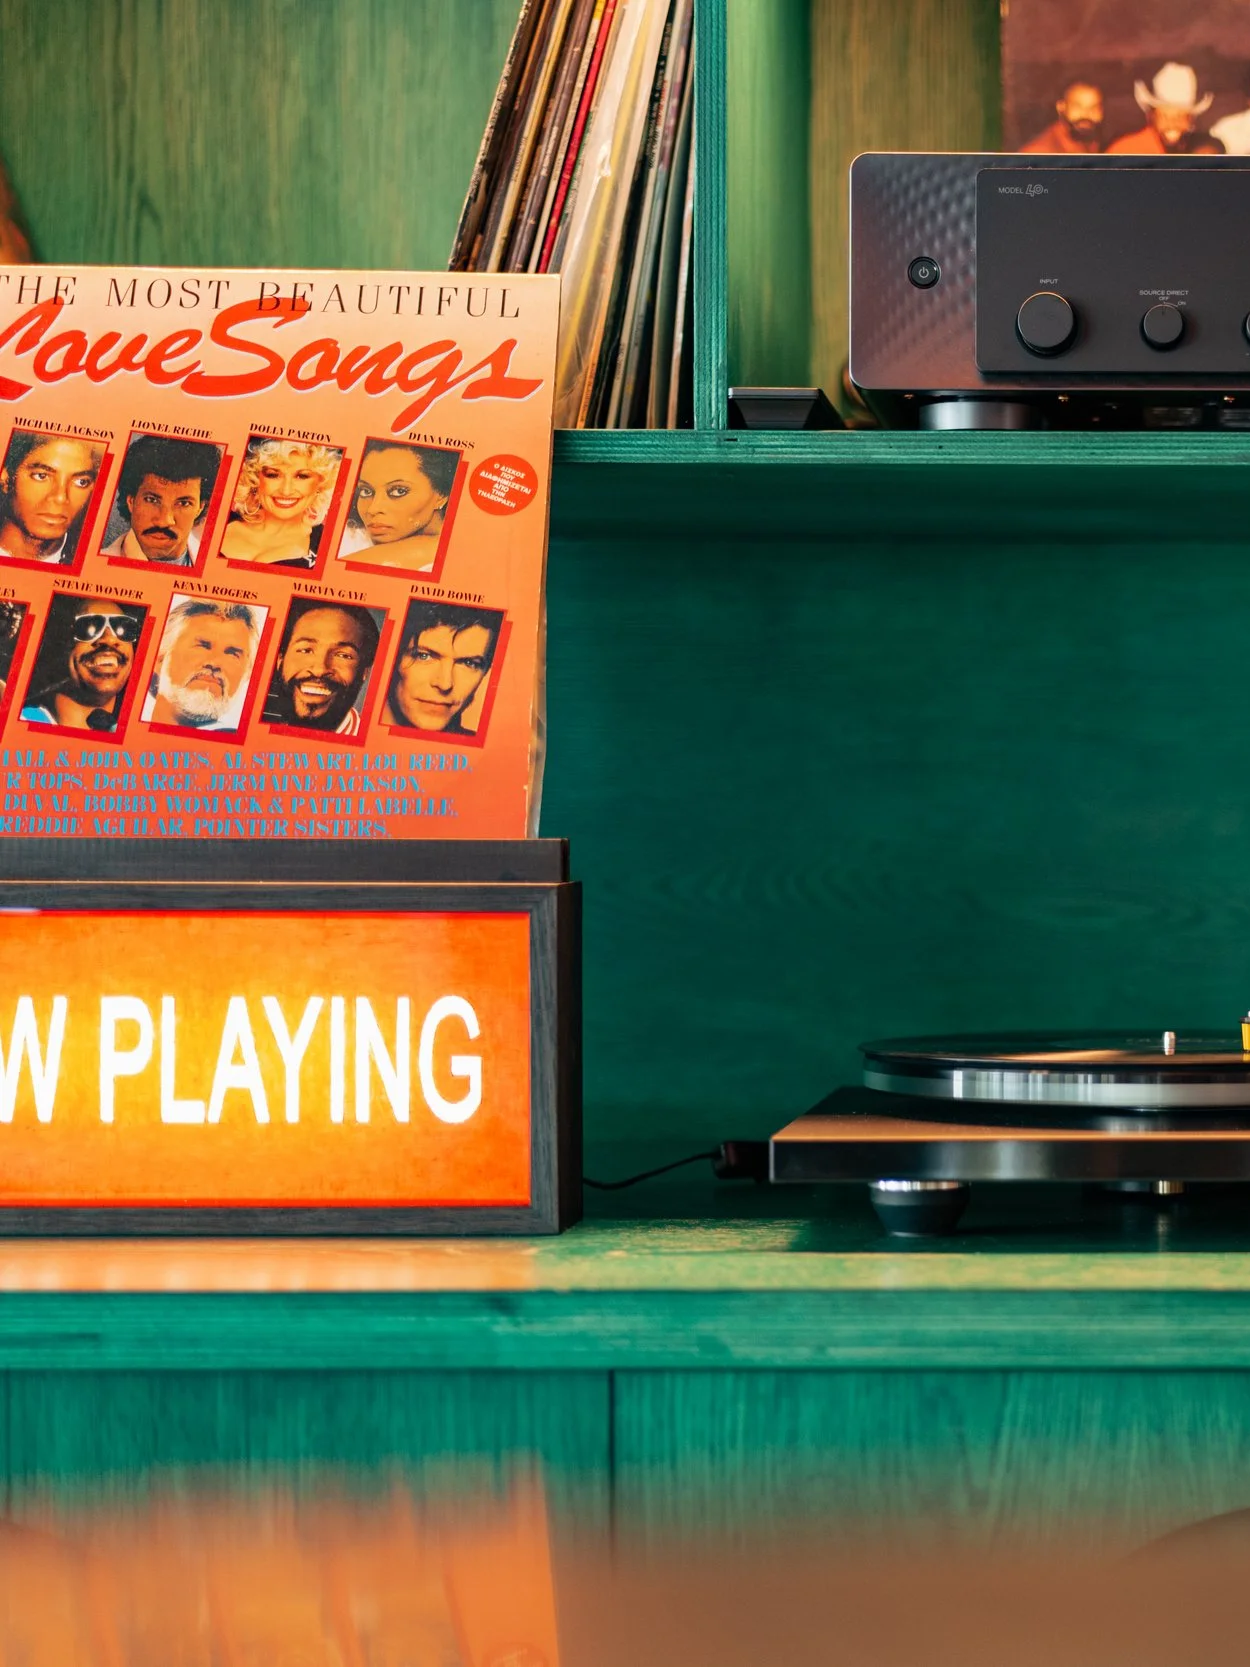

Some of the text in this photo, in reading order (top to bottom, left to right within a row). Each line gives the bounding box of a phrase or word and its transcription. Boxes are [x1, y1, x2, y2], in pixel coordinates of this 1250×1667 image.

[997, 186, 1024, 194] MODEL
[105, 278, 230, 310] MOST
[256, 281, 520, 319] BEAUTIFUL
[14, 416, 116, 440] MICHAEL JACKSON
[131, 419, 213, 439] LIONEL RICHIE
[249, 423, 332, 443] DOLLY PARTON
[408, 432, 476, 450] DIANA ROSS
[53, 578, 144, 599] STEVIE WONDER
[172, 580, 259, 600] KENNY ROGERS
[292, 582, 368, 602] MARVIN GAYE
[410, 584, 486, 604] DAVID BOWIE
[55, 751, 69, 767] &
[76, 751, 137, 768] JOHN
[222, 752, 247, 769] AL
[363, 753, 403, 770] LOU
[206, 774, 318, 792] JERMAINE
[84, 795, 159, 813] BOBBY
[166, 796, 263, 814] WOMACK
[268, 797, 283, 814] &
[291, 797, 352, 815] PATTI
[194, 818, 289, 837] POINTER
[100, 995, 483, 1124] PLAYING
